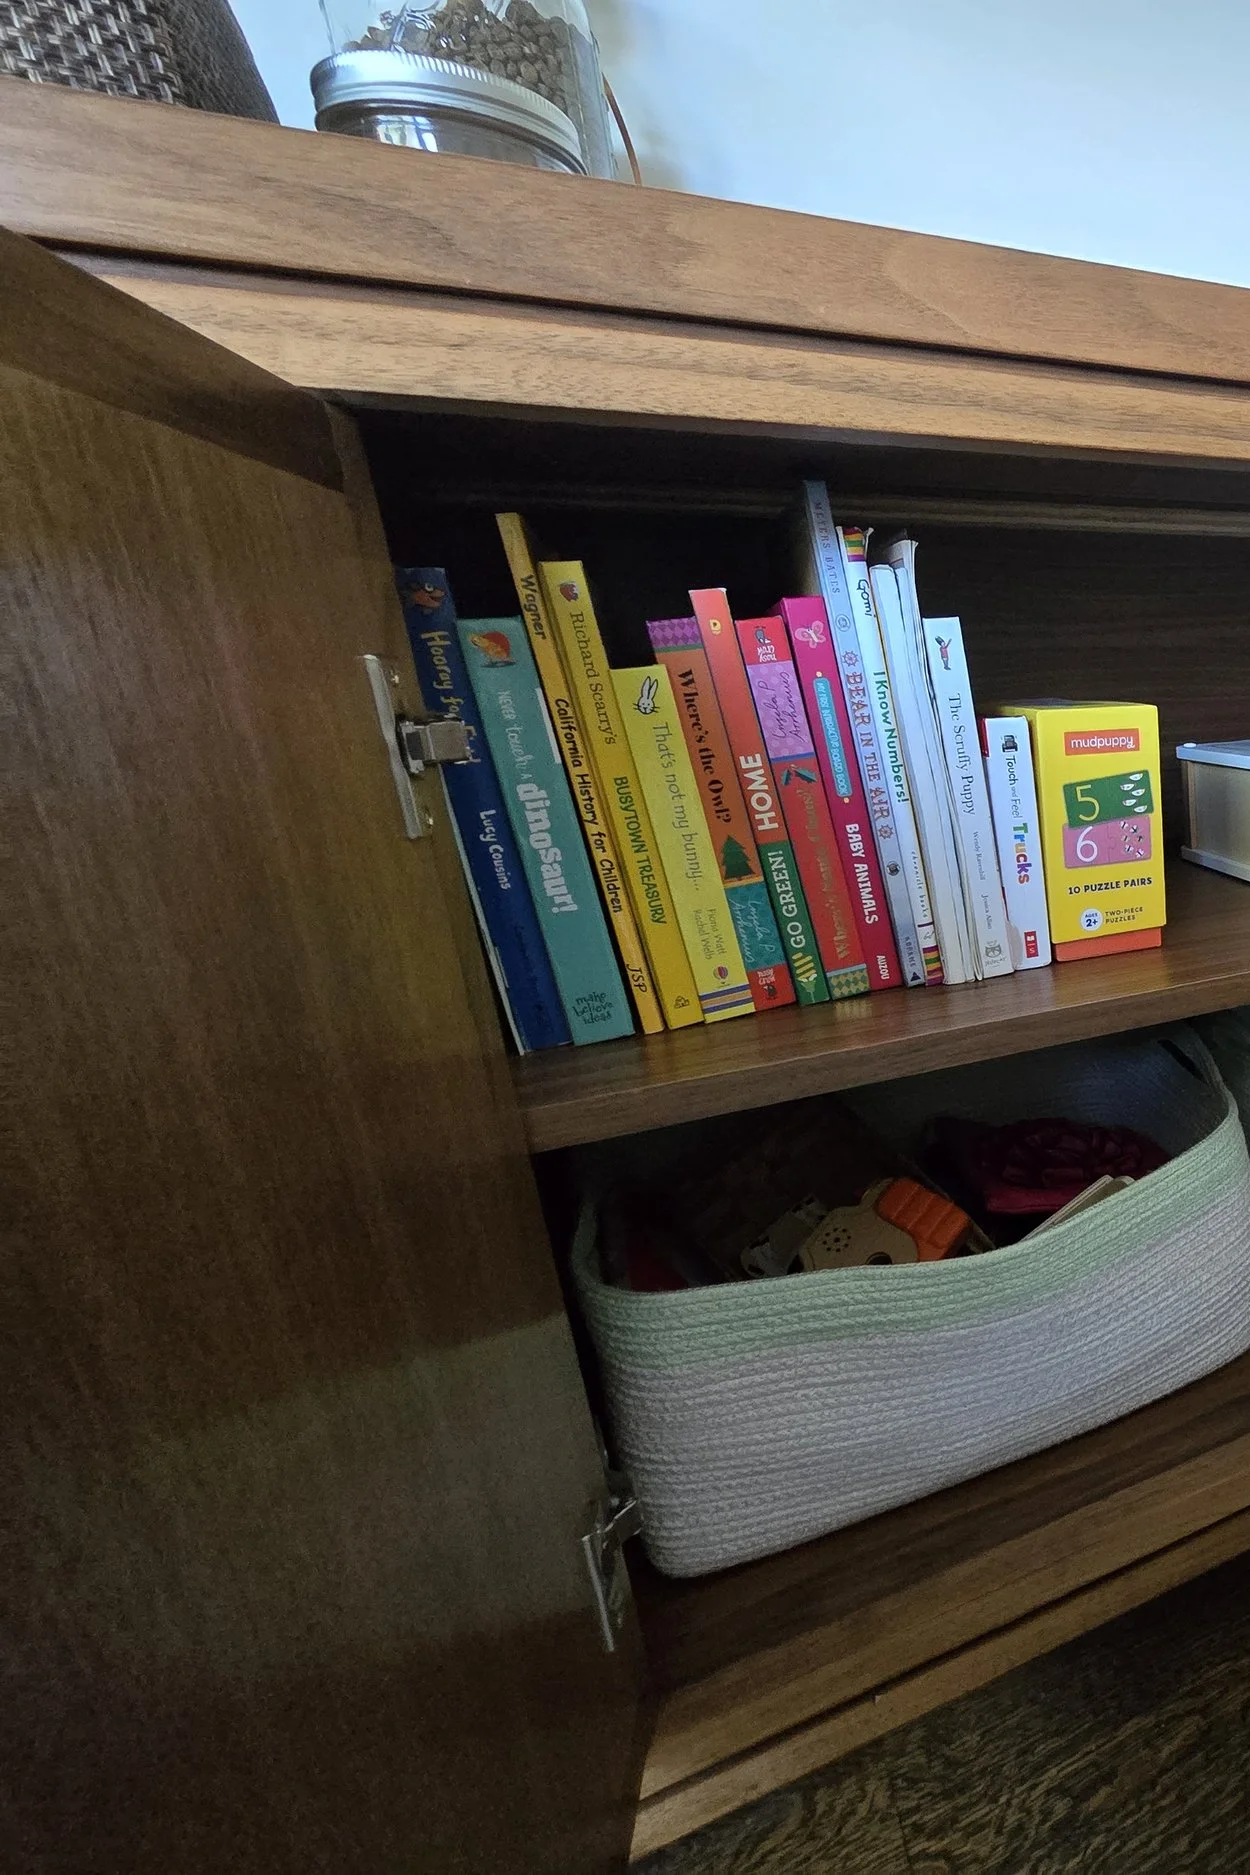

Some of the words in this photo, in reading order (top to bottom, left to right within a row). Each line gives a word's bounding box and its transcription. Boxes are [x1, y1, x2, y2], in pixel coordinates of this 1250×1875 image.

[824, 556, 840, 594] BATES
[520, 574, 546, 640] Wagner
[857, 578, 876, 618] Gomi
[757, 645, 775, 656] crow
[760, 653, 777, 662] nosy
[421, 631, 453, 689] Hooray
[440, 696, 464, 720] for
[570, 611, 600, 678] Richard
[589, 682, 615, 744] Scarry's
[758, 680, 774, 690] P
[498, 690, 515, 720] NEVER
[818, 691, 829, 707] FIRST
[846, 672, 871, 730] BEAR
[949, 693, 962, 721] The
[506, 726, 535, 773] touch
[653, 722, 673, 768] That's
[678, 669, 710, 744] Where's
[698, 748, 715, 776] the
[708, 780, 732, 824] Owl?
[860, 736, 874, 748] IN
[876, 680, 892, 725] Know
[885, 728, 910, 803] Numbers!
[952, 724, 972, 773] Scruffy
[1070, 735, 1136, 750] mudpuppy
[830, 747, 843, 772] BOARD
[864, 752, 882, 782] THE
[665, 774, 682, 804] not
[740, 753, 779, 831] HOME
[835, 773, 848, 795] BOOK
[960, 775, 975, 816] Puppy
[1004, 756, 1016, 786] Touch
[1012, 798, 1022, 818] Feel
[555, 698, 582, 768] California
[575, 774, 598, 825] History
[590, 831, 606, 854] for
[600, 859, 622, 913] Children
[870, 785, 890, 822] AIR
[1075, 784, 1100, 820] 5
[672, 805, 688, 830] my
[479, 809, 496, 842] Lucy
[488, 844, 511, 890] Cousins
[516, 782, 578, 913] dinosaur!
[614, 776, 648, 853] BUSYTOWN
[636, 857, 667, 925] TREASURY
[846, 823, 865, 858] BABY
[972, 831, 982, 852] Wendy
[1012, 822, 1029, 884] Trucks
[1076, 826, 1098, 862] 6
[683, 832, 702, 892] bunny...
[768, 850, 797, 917] GREEN!
[854, 864, 878, 924] ANIMALS
[911, 851, 923, 889] chronicle
[917, 894, 927, 918] books
[1068, 886, 1080, 895] 10
[1084, 880, 1120, 892] PUZZLE
[1124, 876, 1152, 888] PAIRS
[706, 908, 720, 929] Fiona
[981, 894, 990, 913] Jessica
[1105, 907, 1143, 916] TWO-PIECE
[694, 909, 708, 936] Rachel
[1086, 919, 1098, 928] 2+
[1106, 915, 1136, 924] PUZZLES
[711, 931, 727, 955] Watt
[787, 922, 806, 948] GO
[626, 964, 647, 993] JSP
[876, 954, 890, 980] AUZOU
[572, 1001, 614, 1017] believe
[576, 992, 606, 1005] make
[583, 1012, 612, 1025] ideas
